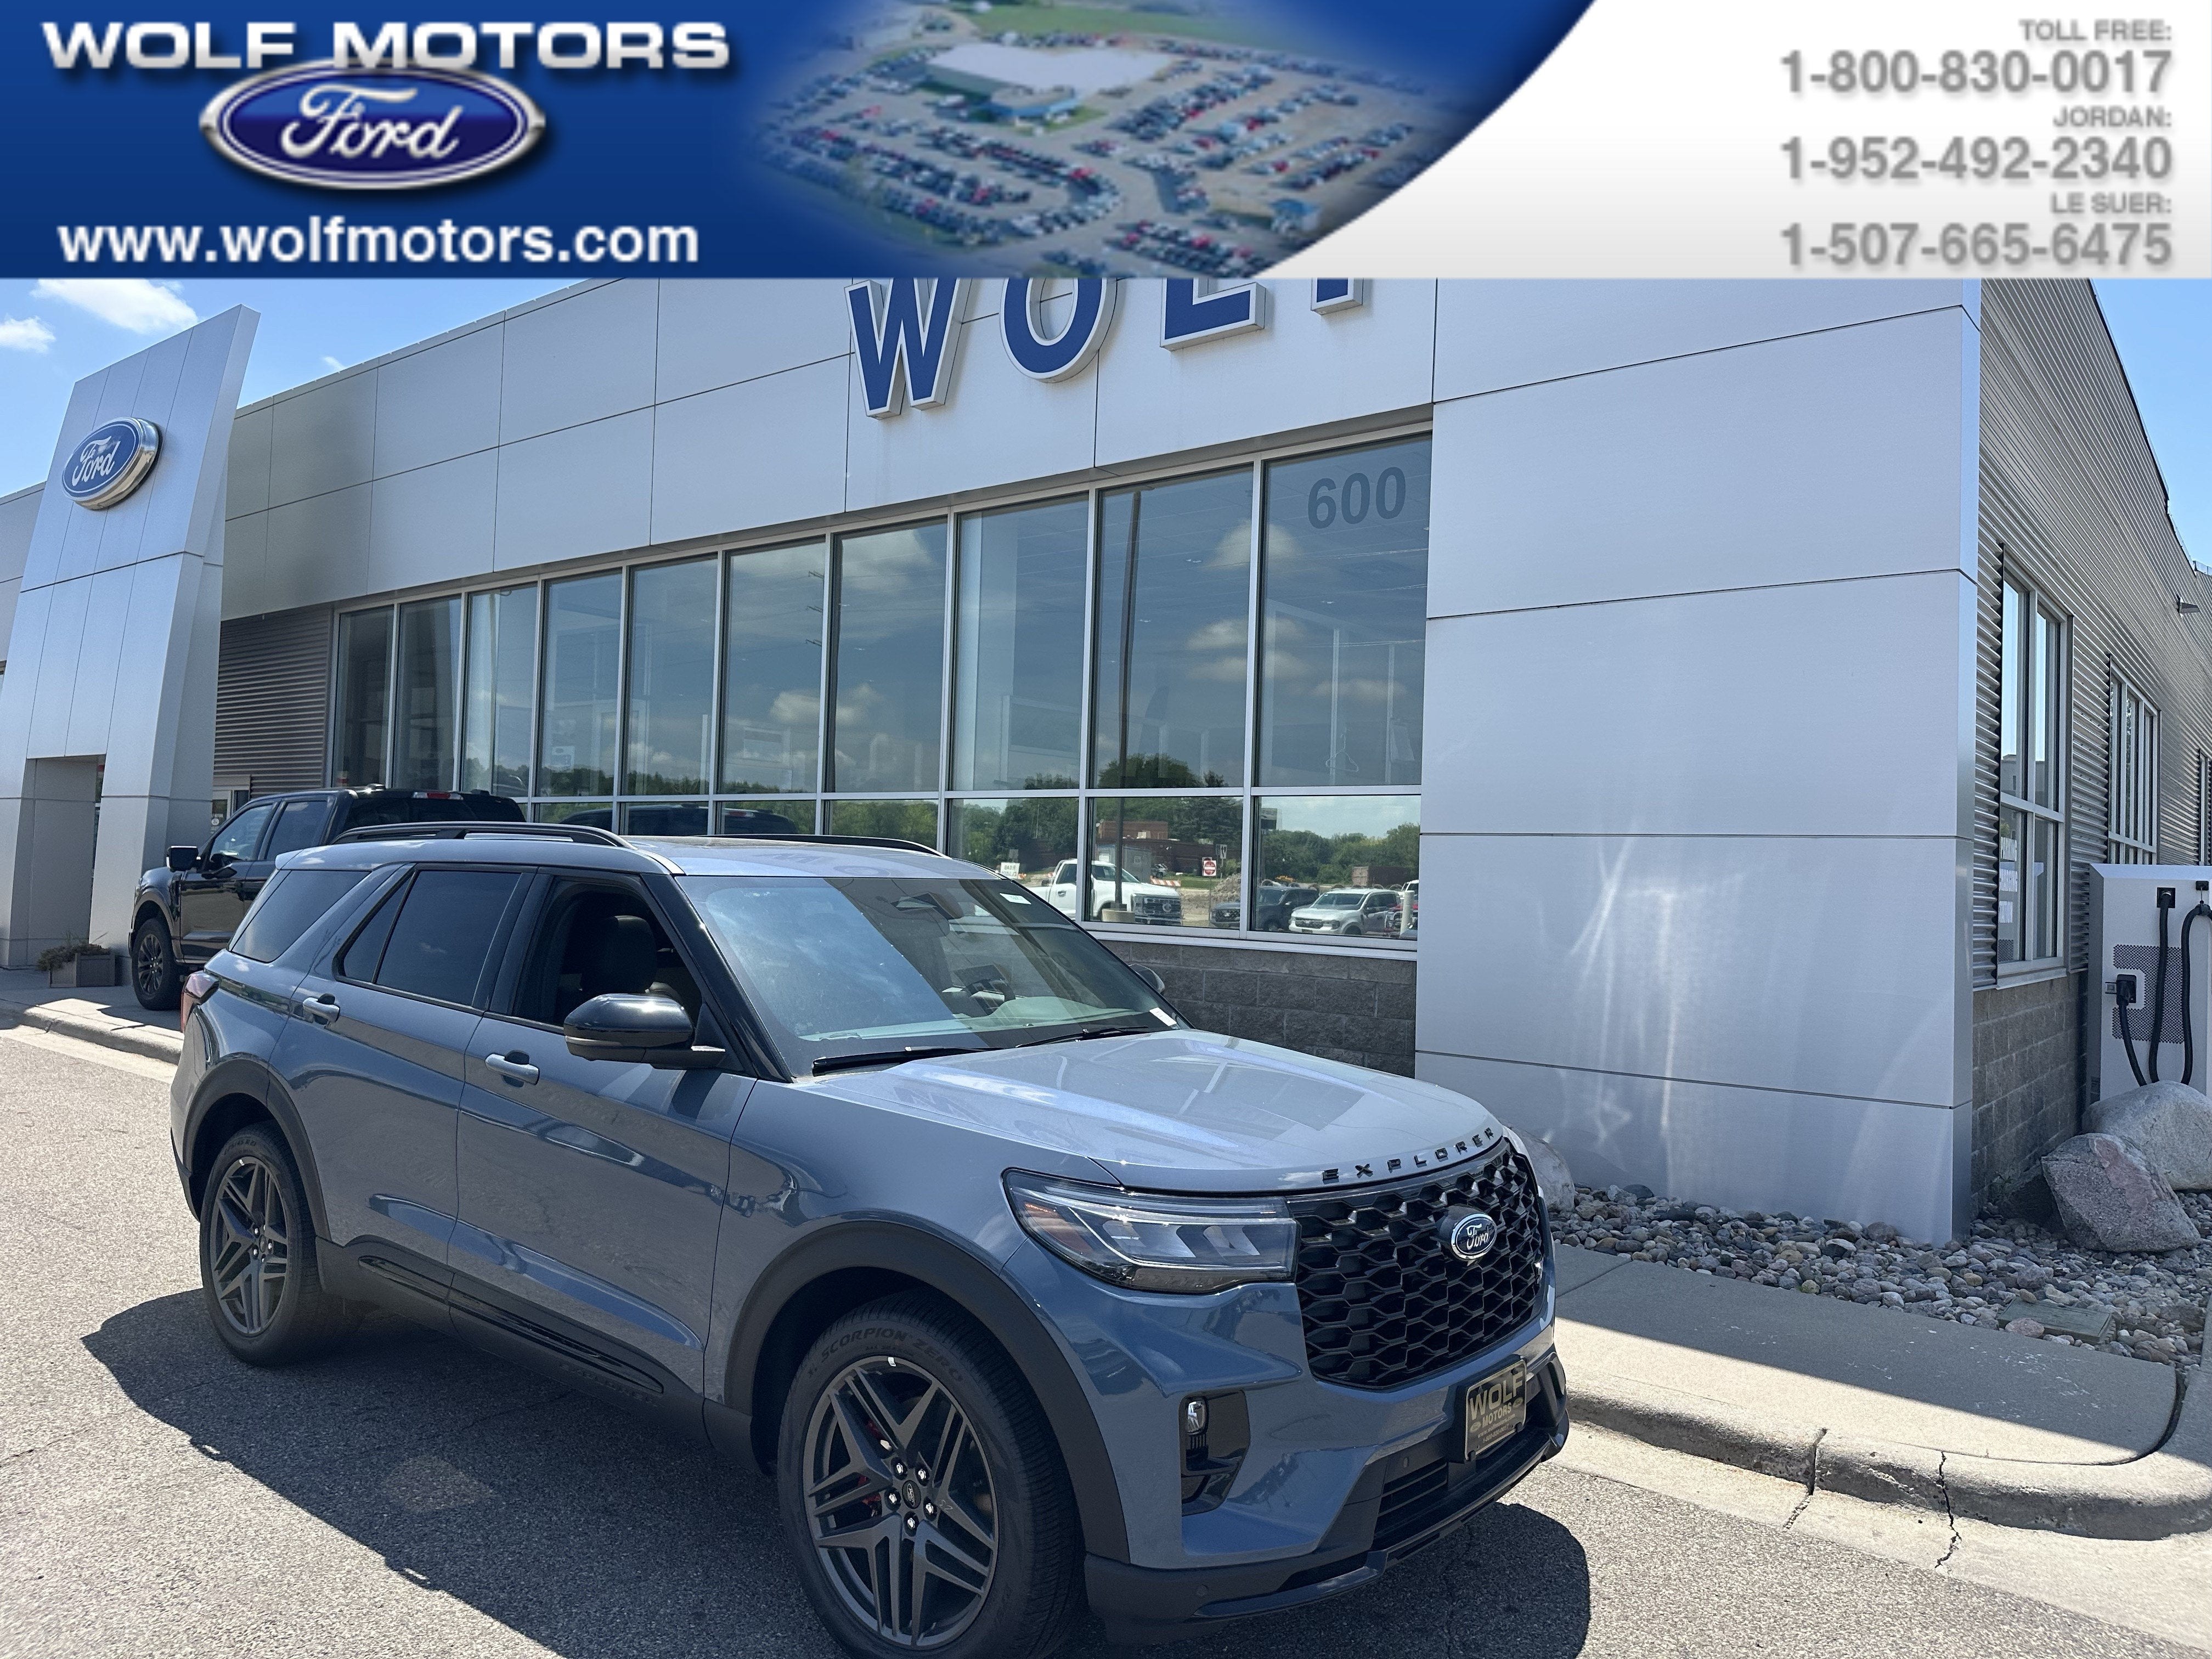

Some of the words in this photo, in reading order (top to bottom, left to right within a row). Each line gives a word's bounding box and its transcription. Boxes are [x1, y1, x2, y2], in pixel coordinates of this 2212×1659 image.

[845, 279, 1363, 419] WOL
[72, 436, 121, 486] Ford
[1307, 466, 1407, 529] 600
[1322, 1127, 1494, 1182] EXPLORER
[1465, 1223, 1490, 1250] Ford
[822, 1327, 906, 1362] SCORPION
[913, 1338, 963, 1382] ZERO
[1470, 1371, 1523, 1420] WOLF
[1482, 1402, 1511, 1429] MOTORS
